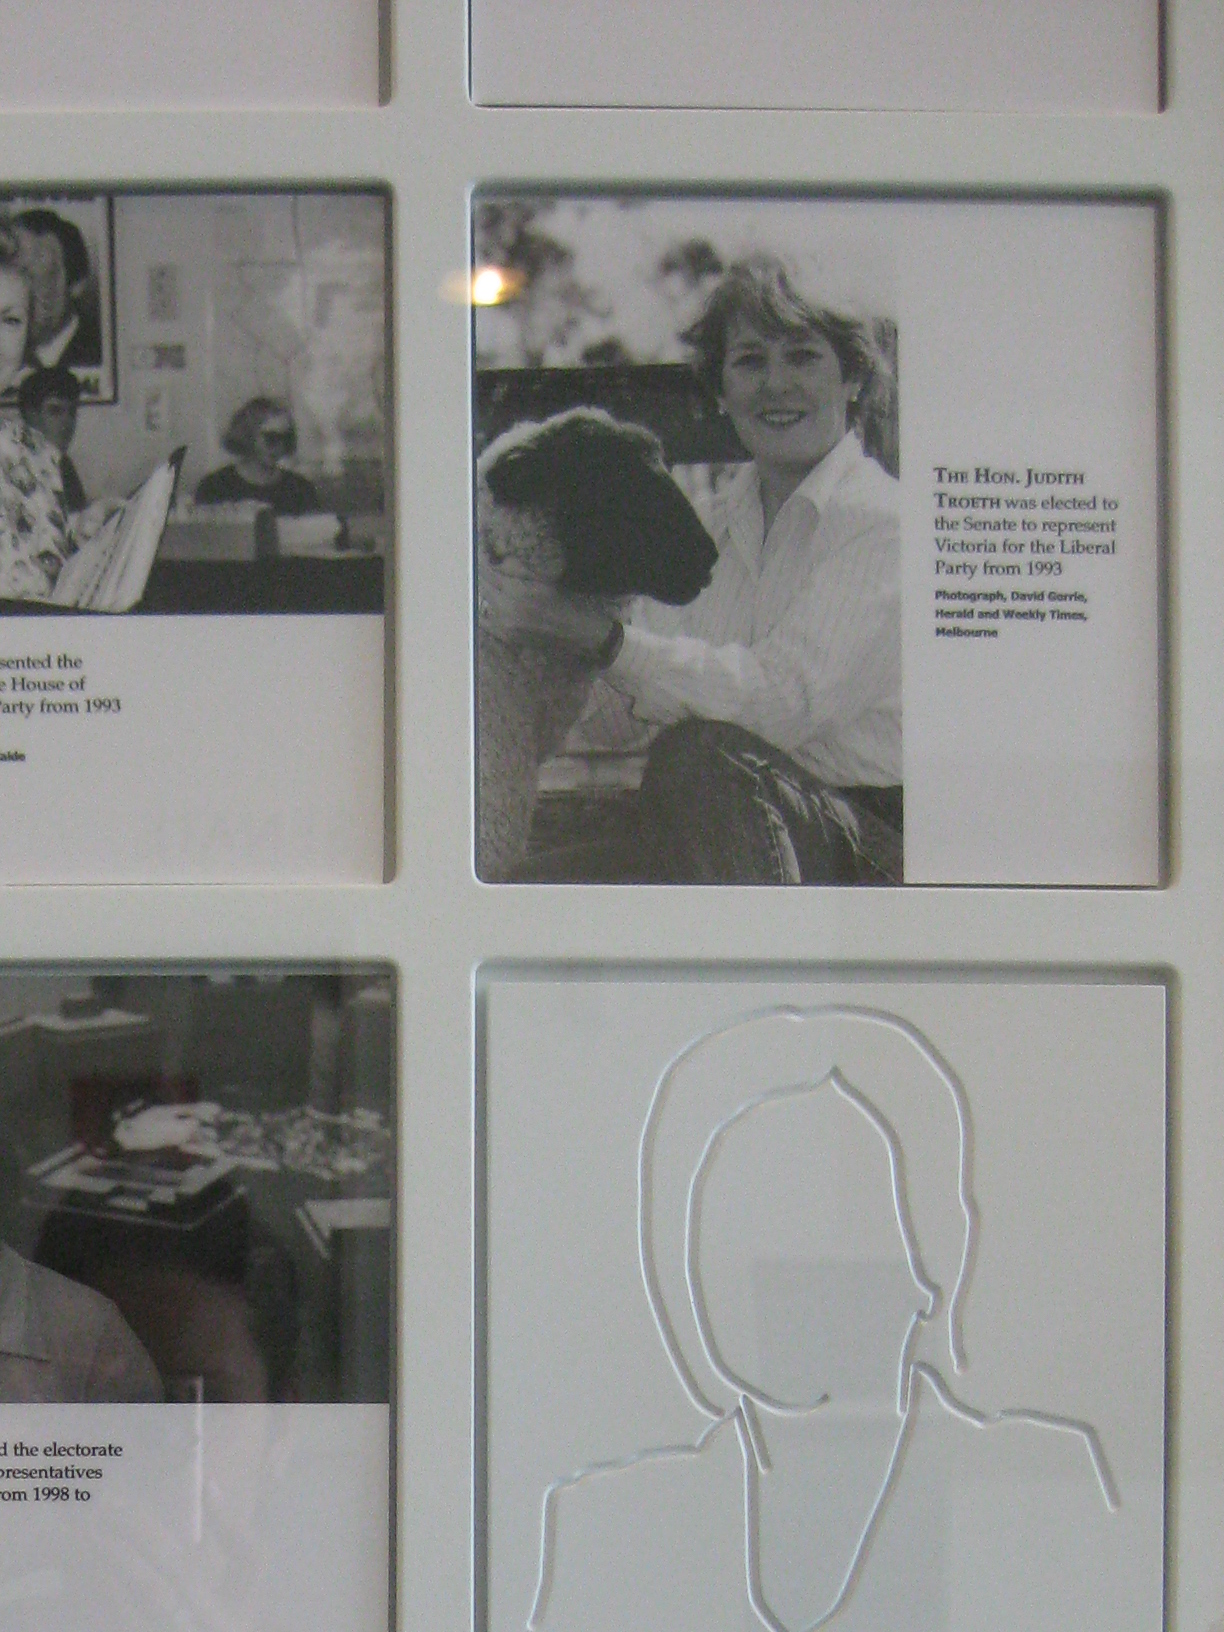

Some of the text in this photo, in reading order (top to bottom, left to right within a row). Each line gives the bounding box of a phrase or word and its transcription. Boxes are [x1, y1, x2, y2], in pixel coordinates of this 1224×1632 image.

[1005, 498, 1037, 510] was
[1041, 494, 1097, 511] elected
[1102, 497, 1118, 510] to
[934, 515, 1116, 537] the Senate to represent
[935, 560, 1062, 579] Party from 1993
[57, 652, 83, 669] the
[13, 1442, 39, 1456] the
[43, 1442, 123, 1457] electorate
